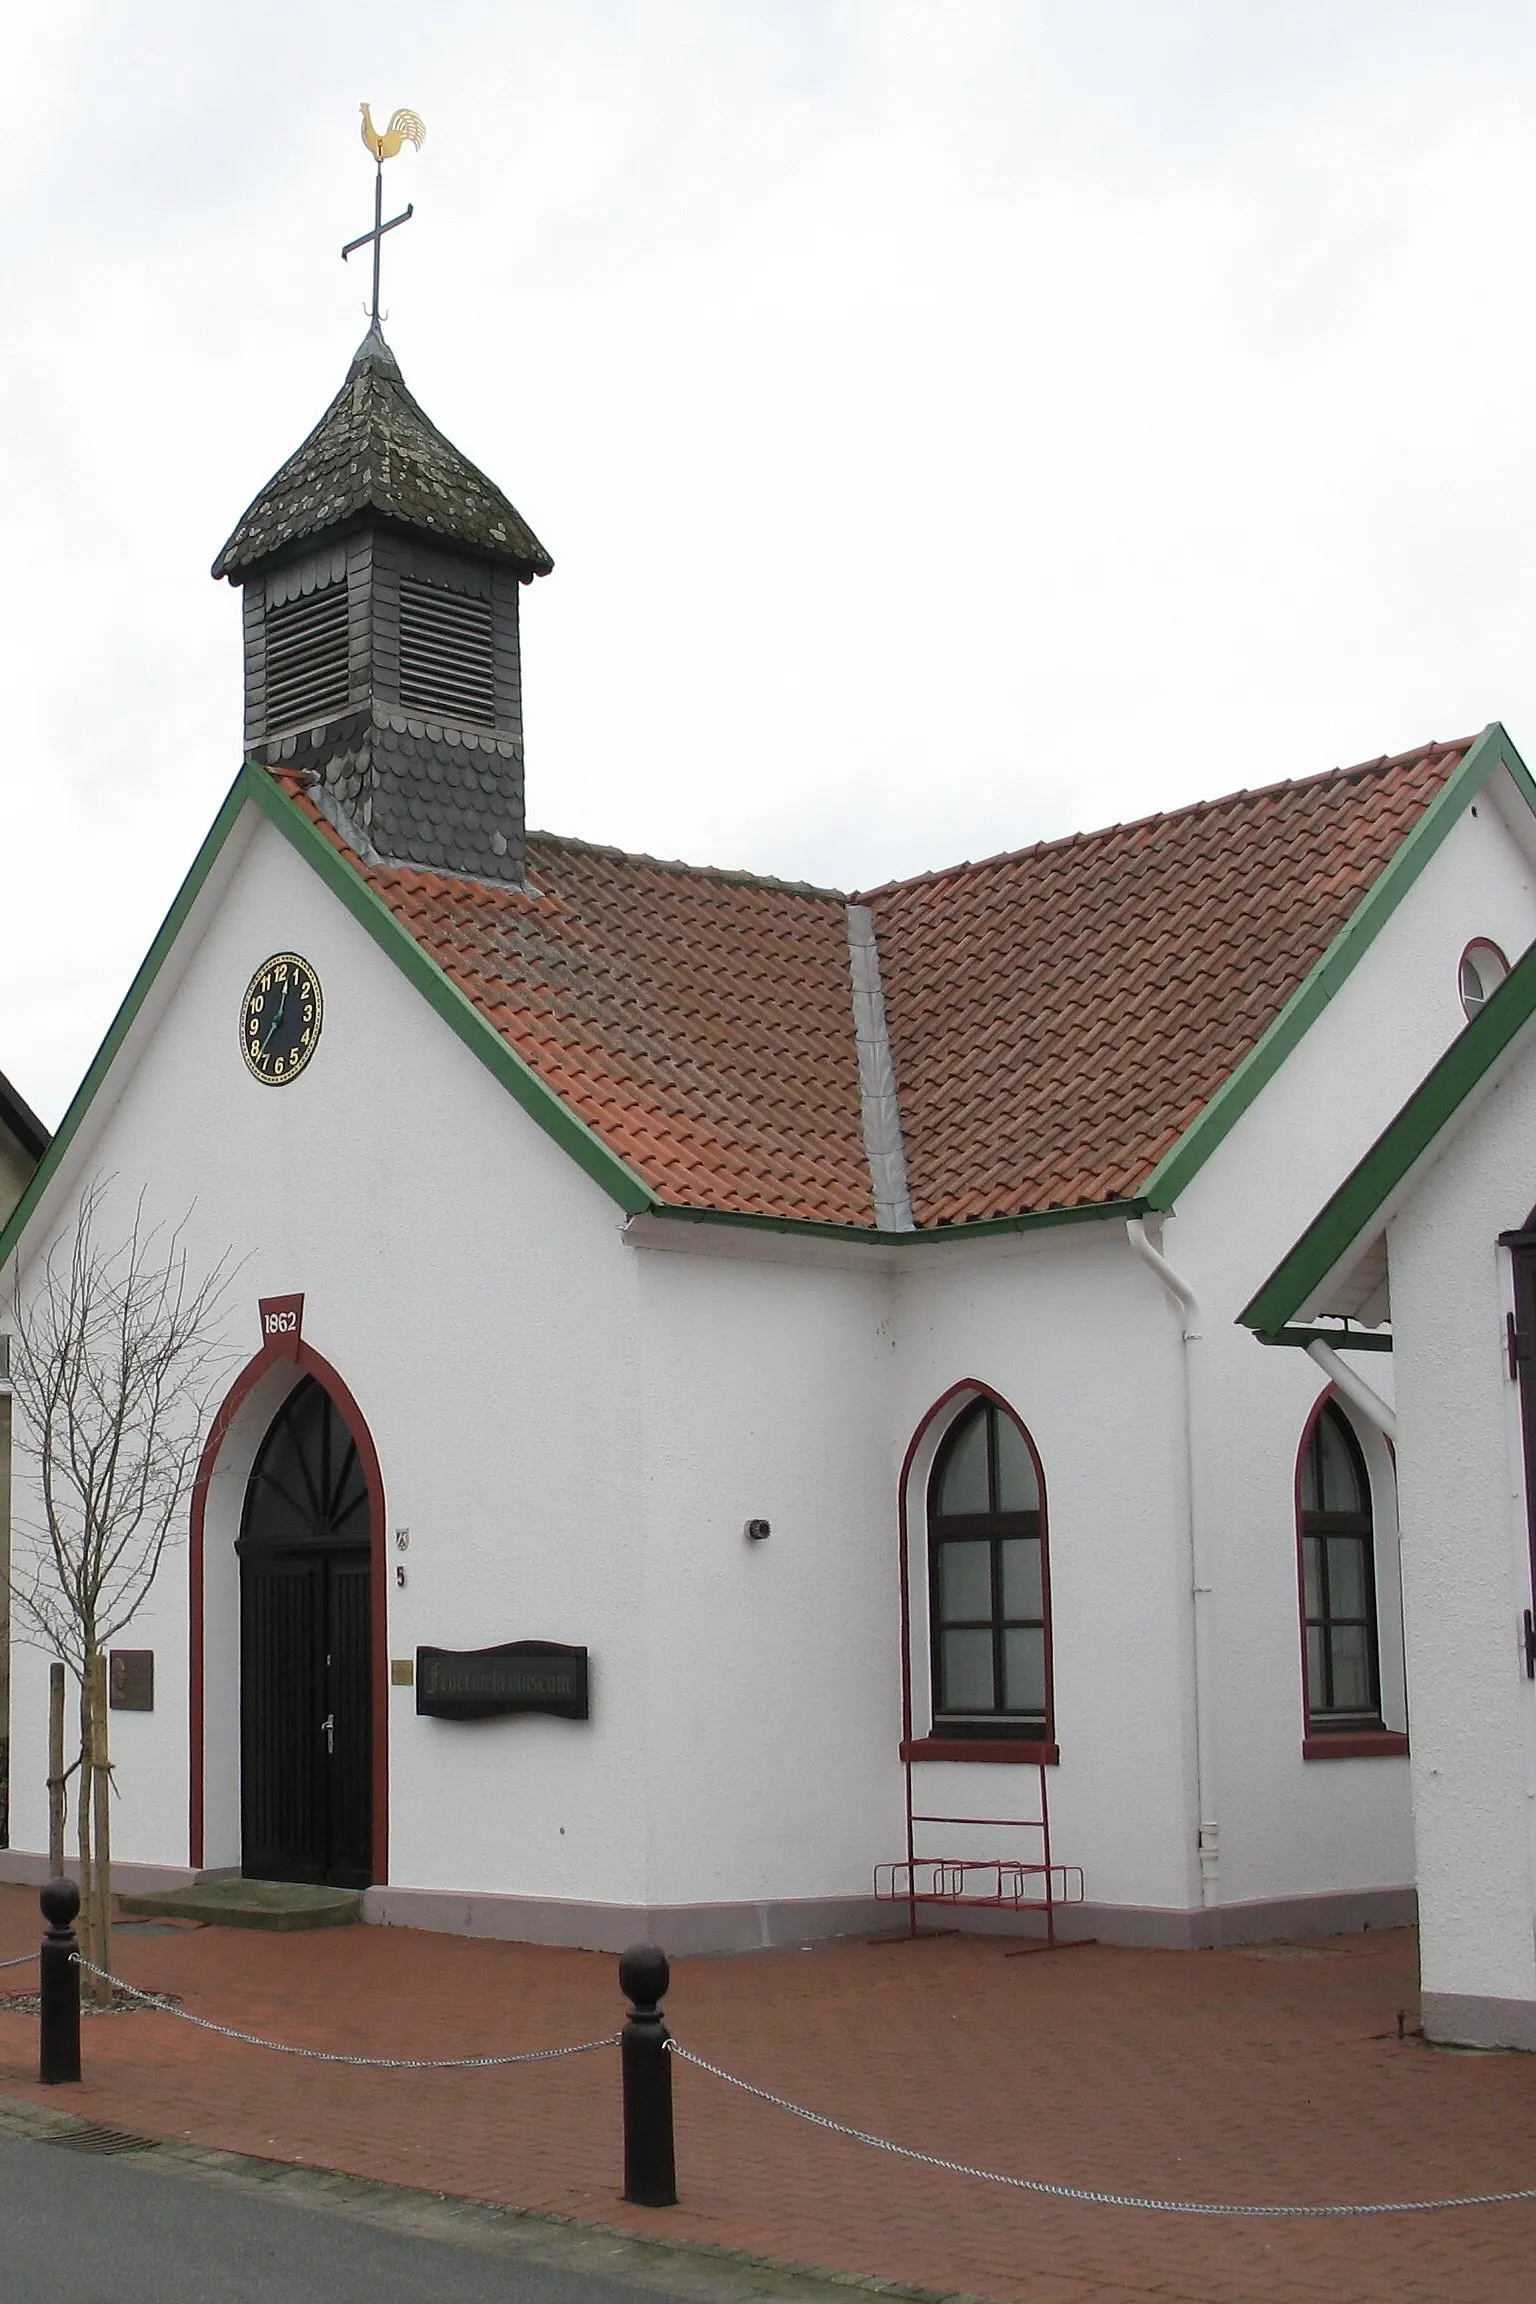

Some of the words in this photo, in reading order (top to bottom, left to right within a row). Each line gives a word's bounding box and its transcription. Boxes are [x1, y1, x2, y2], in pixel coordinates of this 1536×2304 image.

[274, 964, 288, 983] 12
[293, 968, 300, 986] 1
[261, 974, 271, 992] 11
[301, 981, 311, 1000] 2
[250, 995, 264, 1014] 10
[303, 1004, 313, 1022] 3
[249, 1018, 259, 1036] 9
[301, 1028, 311, 1046] 4
[250, 1039, 260, 1057] 8
[289, 1047, 299, 1065] 5
[262, 1053, 271, 1071] 7
[274, 1056, 284, 1074] 6
[264, 1311, 297, 1334] 1862
[396, 1565, 405, 1587] 5
